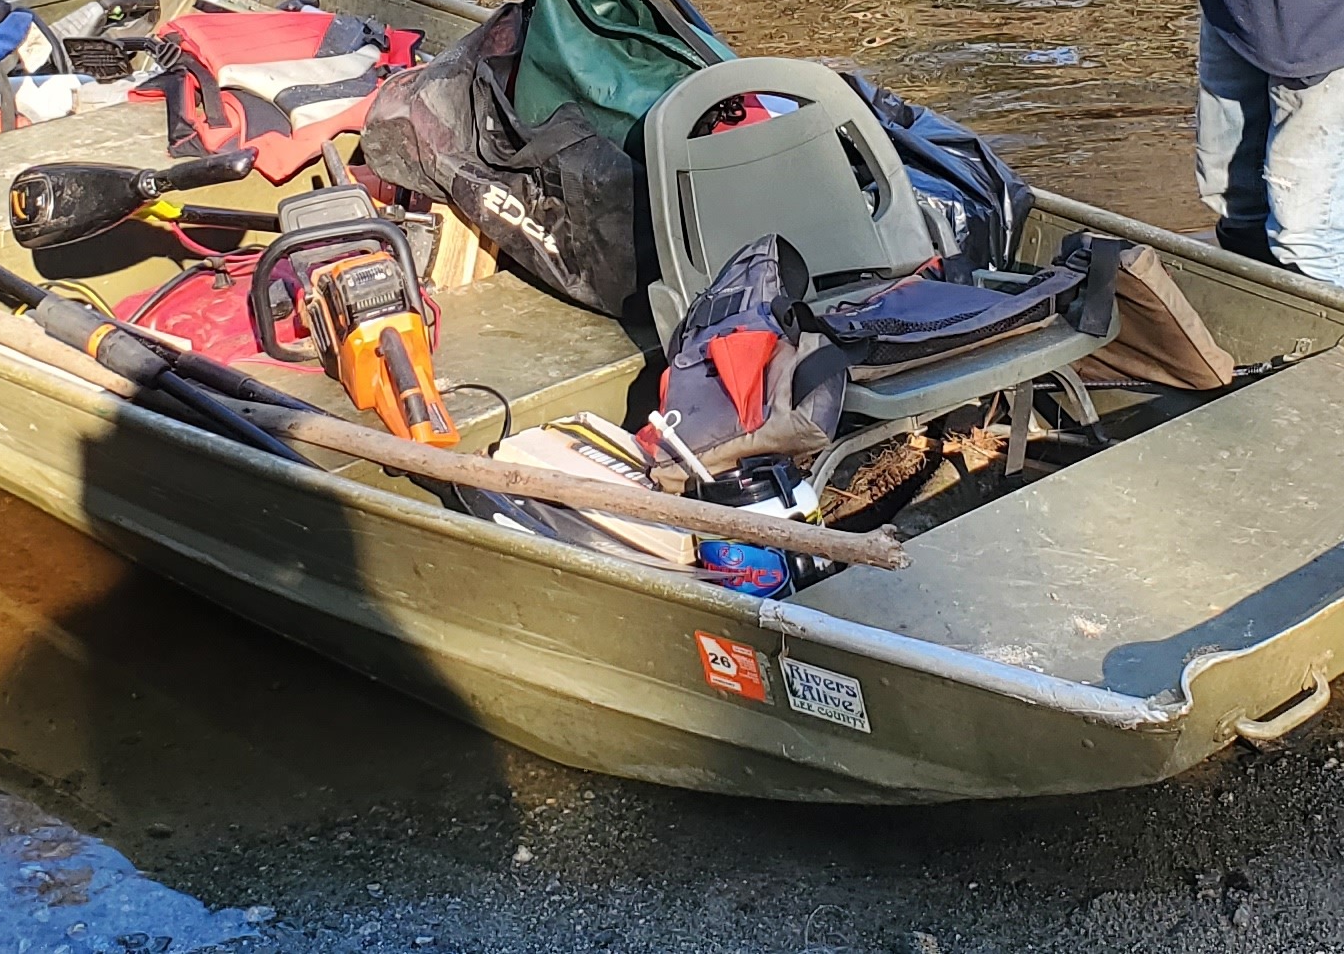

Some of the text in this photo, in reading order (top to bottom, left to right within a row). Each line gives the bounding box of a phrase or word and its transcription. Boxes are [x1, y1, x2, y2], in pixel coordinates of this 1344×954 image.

[708, 652, 732, 669] 26
[787, 662, 858, 699] Rivers
[799, 682, 856, 713] Alive
[792, 698, 867, 730] LEE COUNTY
